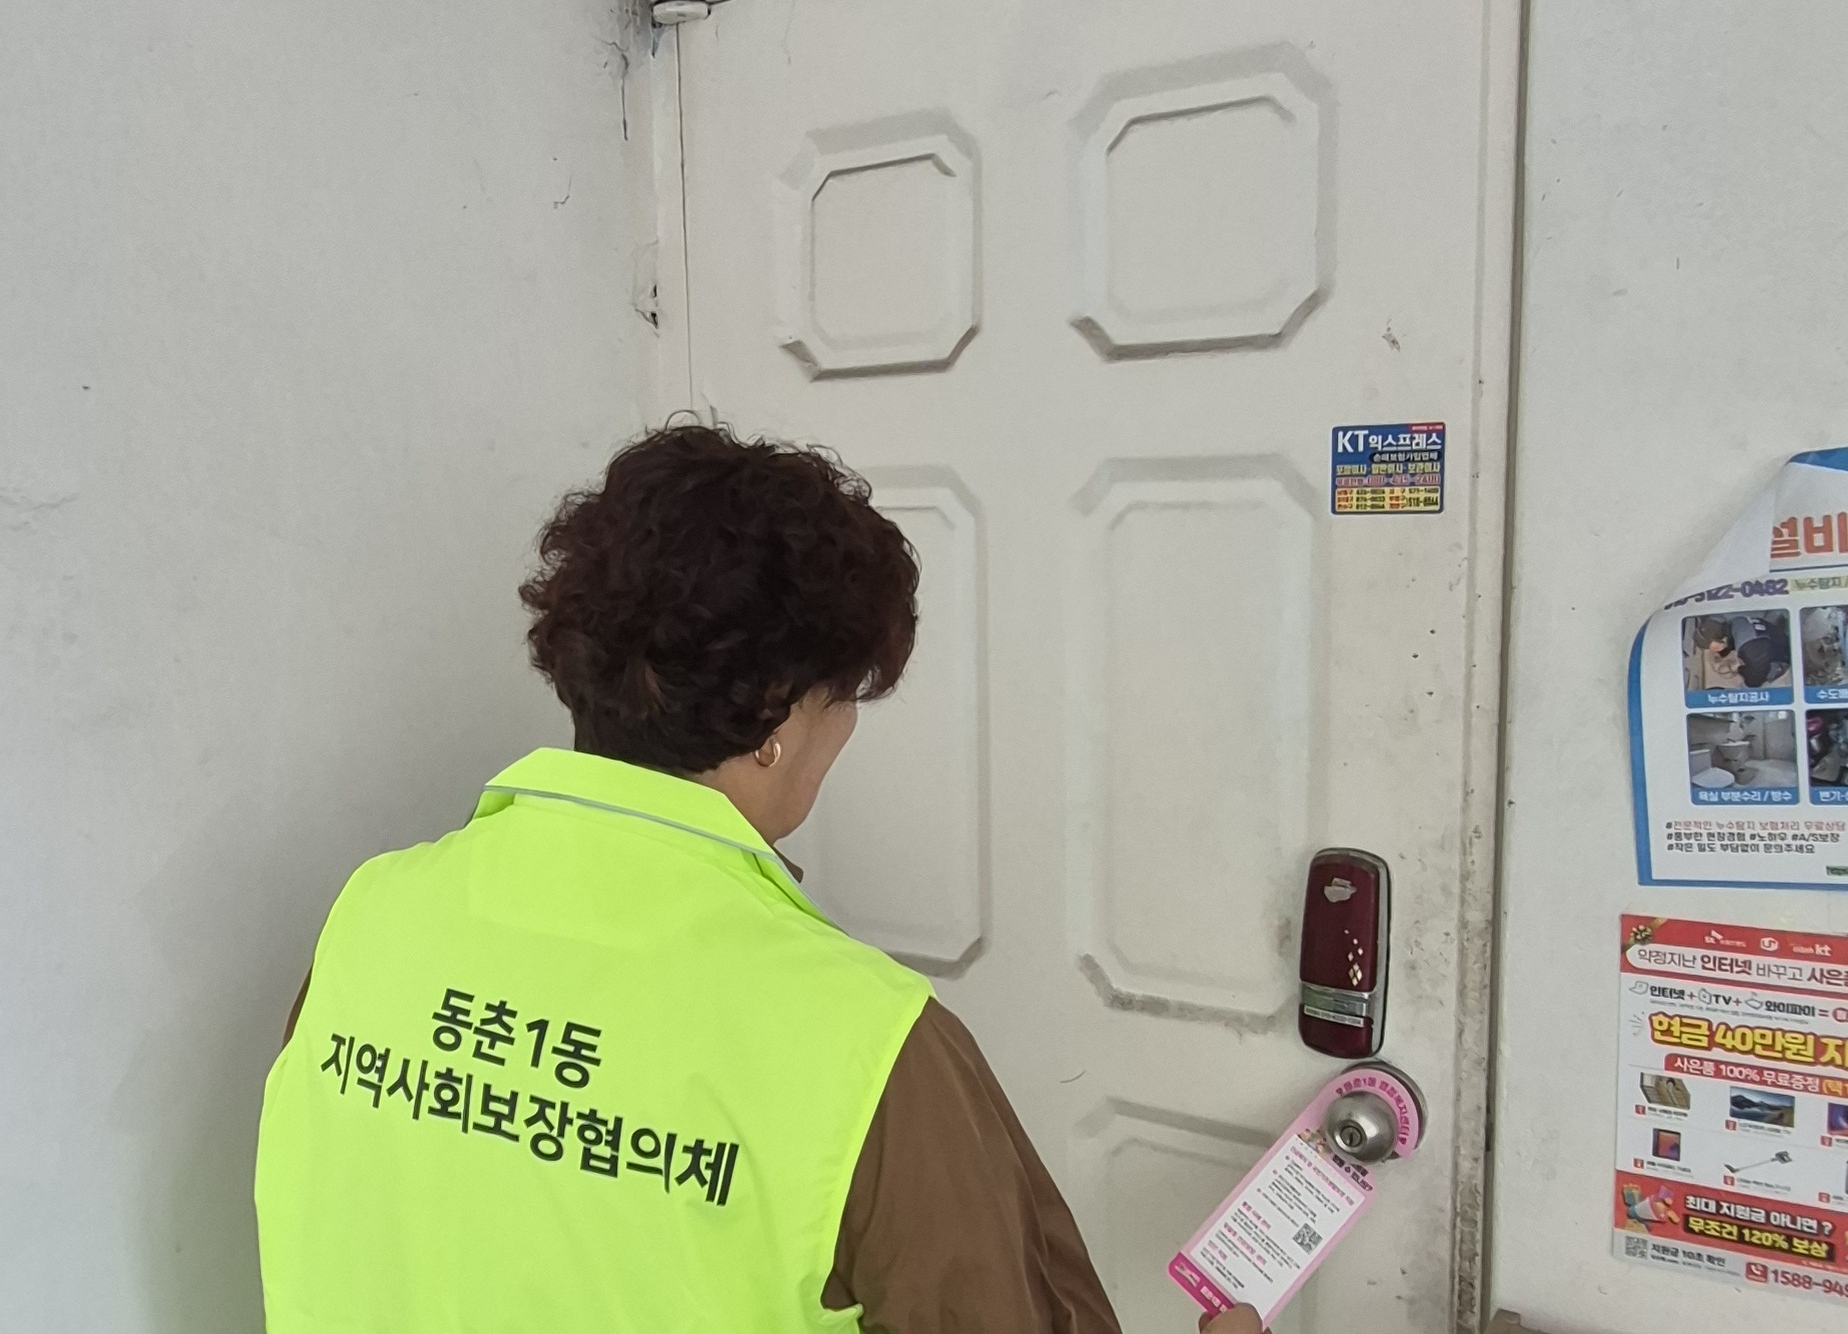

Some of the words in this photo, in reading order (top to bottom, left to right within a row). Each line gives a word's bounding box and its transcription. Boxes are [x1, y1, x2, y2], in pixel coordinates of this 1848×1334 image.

[1337, 430, 1442, 453] KT익스프레스
[1763, 843, 1815, 854] 문의주세요
[1637, 949, 1697, 969] 약정지난
[1700, 954, 1752, 975] 인터넷
[1756, 962, 1803, 981] 바꾸고
[1807, 967, 1848, 987] 사은
[1765, 1000, 1816, 1017] 와이파이
[431, 987, 603, 1090] 동춘1동
[1650, 1012, 1711, 1049] 현금
[1714, 1023, 1816, 1063] 40만원
[1674, 1057, 1715, 1076] 사은품
[1719, 1064, 1760, 1082] 100%
[1762, 1070, 1820, 1093] 무료증정
[320, 1033, 739, 1207] 지역사회보장협의체
[1685, 1195, 1717, 1214] 최대
[1719, 1201, 1767, 1224] 지원금
[1769, 1211, 1818, 1234] 아니면
[1688, 1216, 1739, 1241] 무조건
[1741, 1227, 1789, 1250] 120%
[1792, 1237, 1829, 1258] 보상
